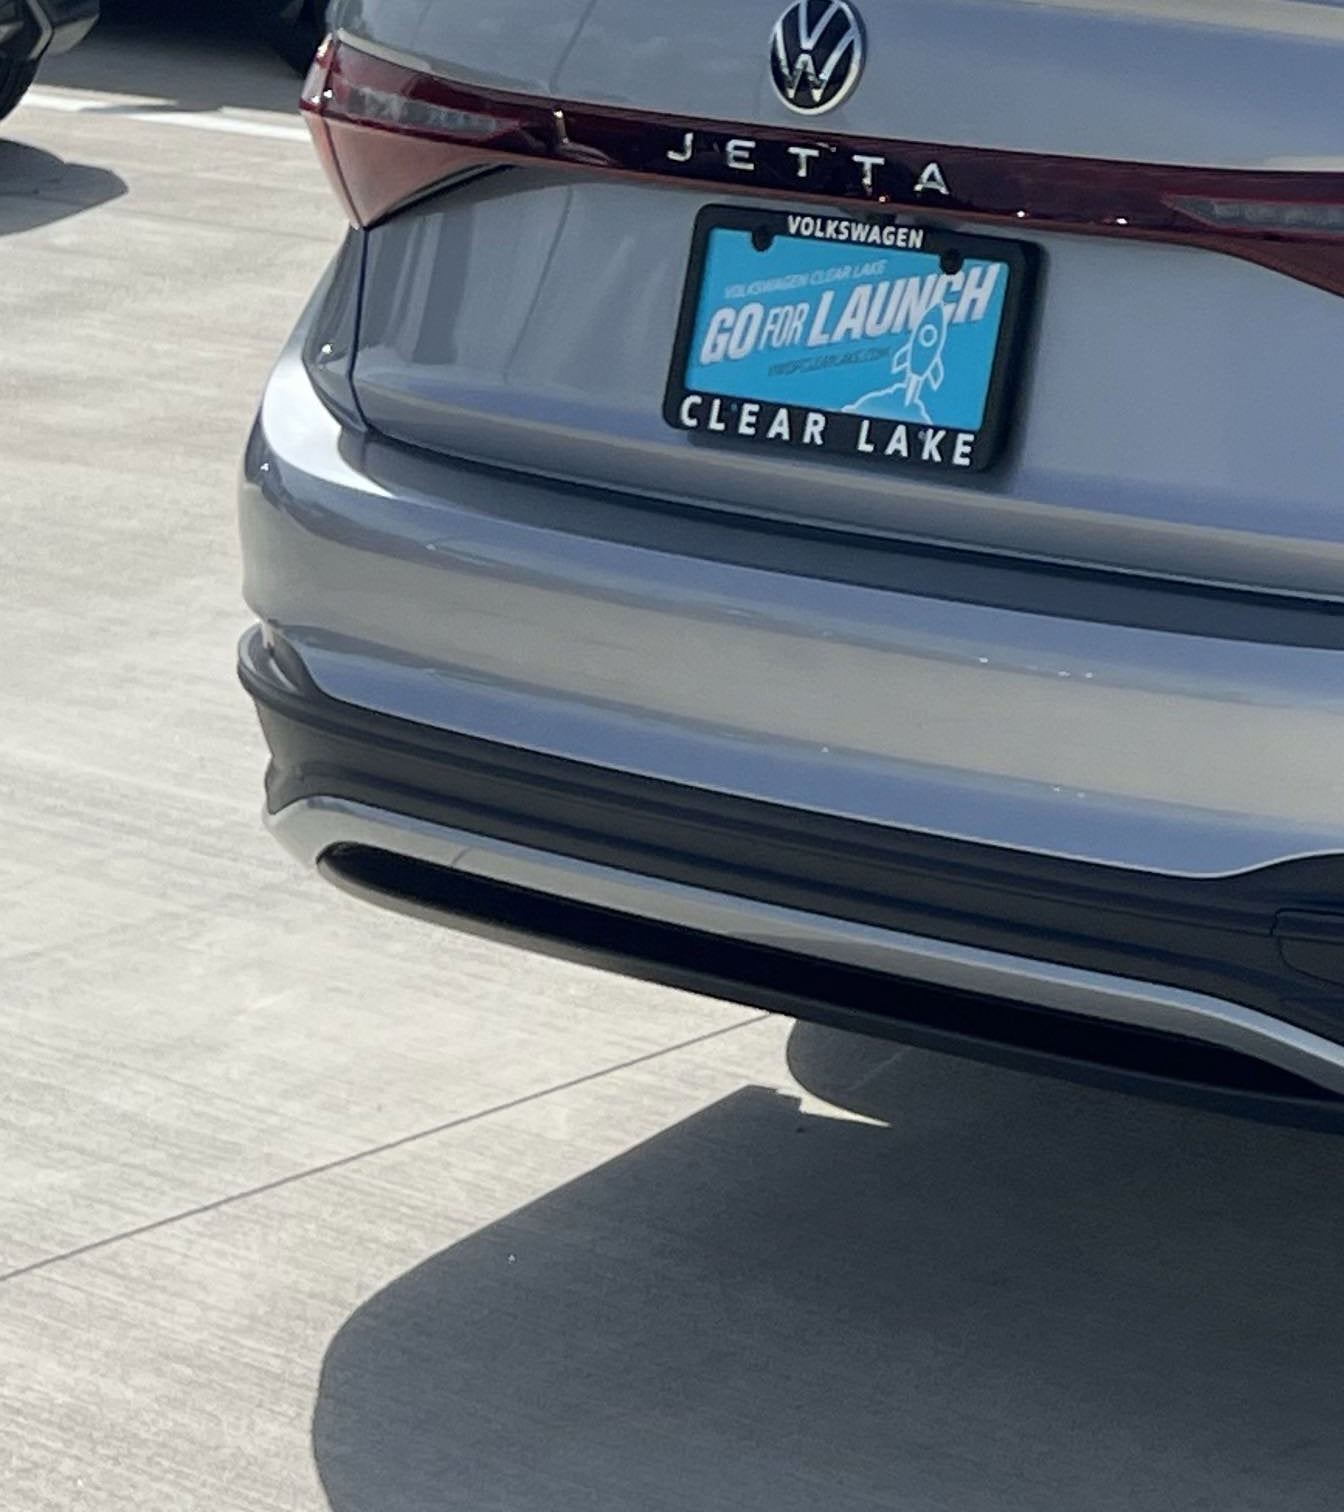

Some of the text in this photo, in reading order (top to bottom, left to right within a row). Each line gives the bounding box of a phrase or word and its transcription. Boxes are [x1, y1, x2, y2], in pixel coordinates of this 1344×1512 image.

[666, 132, 951, 197] JETTA
[788, 215, 924, 249] VOLKSWAGEN
[854, 259, 889, 279] LAKE
[700, 262, 1001, 366] GO FOR LAUNCH
[679, 394, 976, 467] CLEAR LAKE
